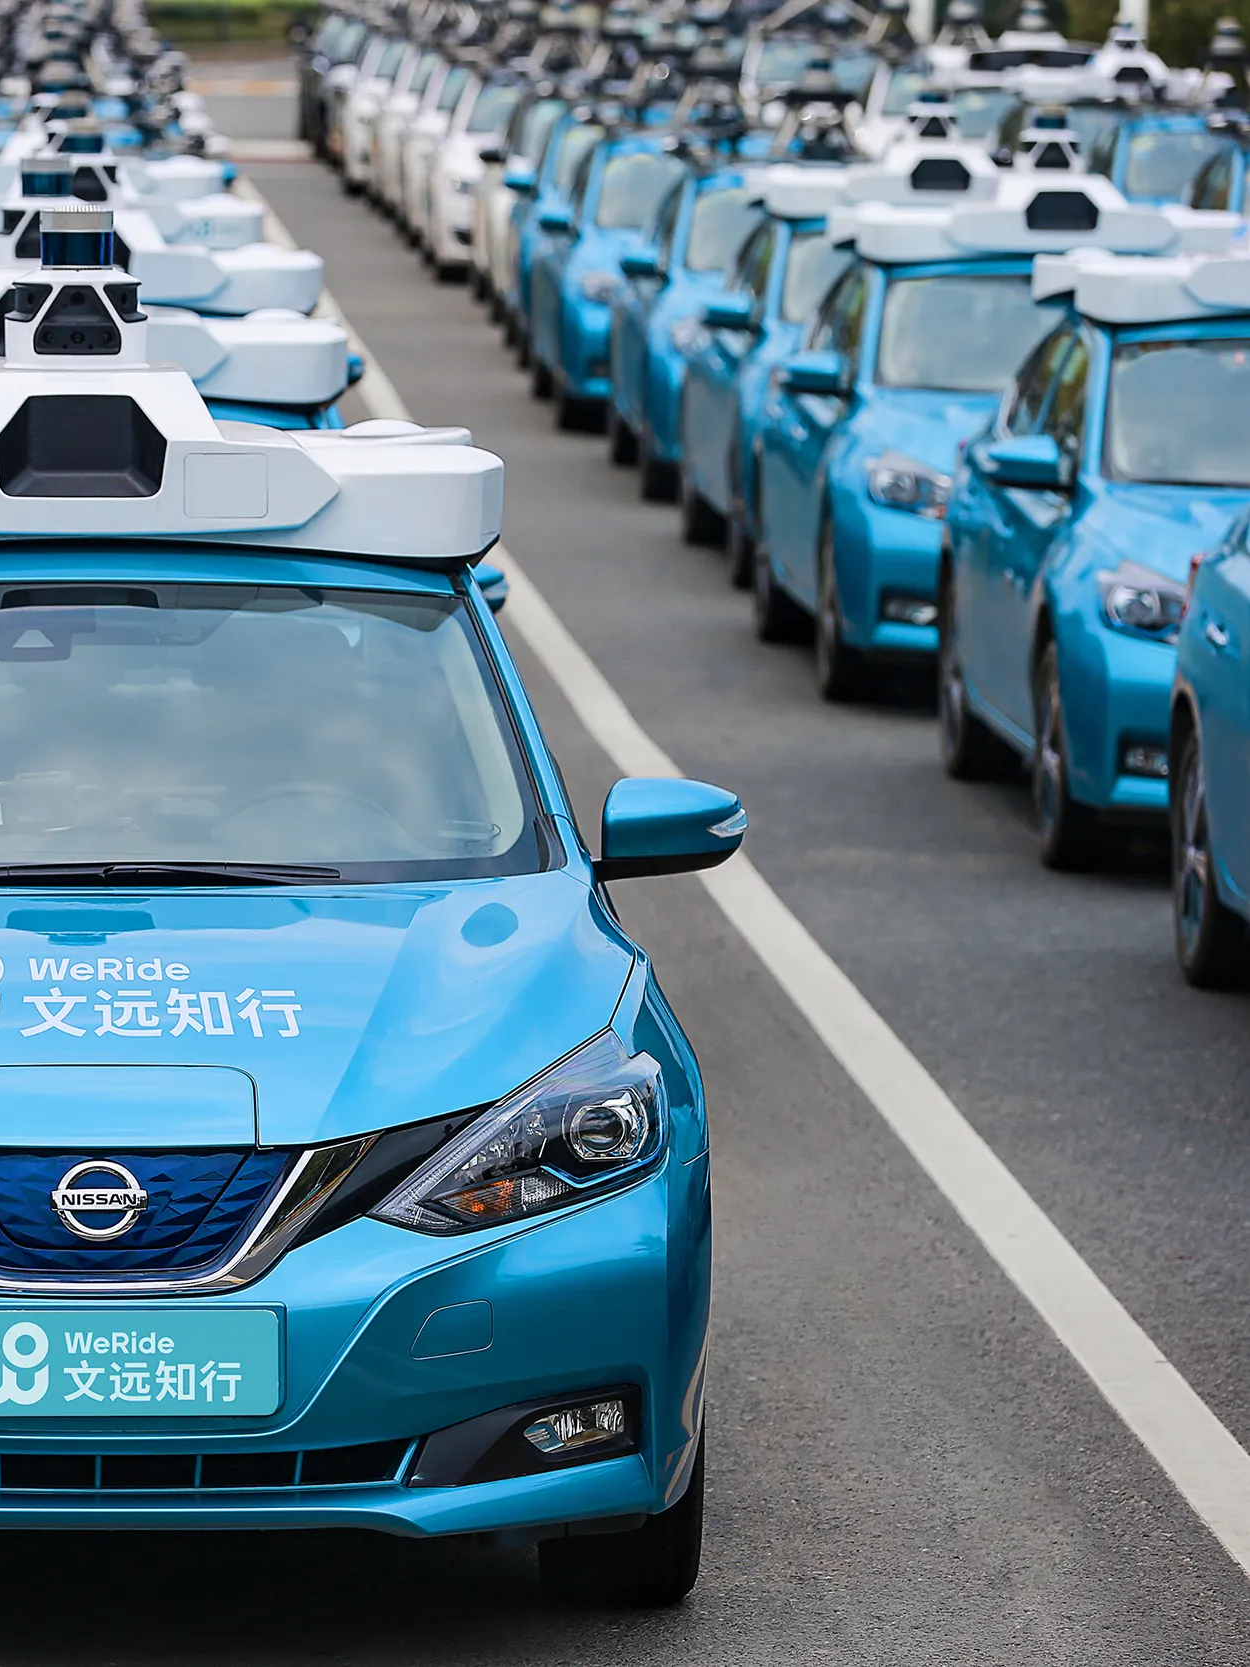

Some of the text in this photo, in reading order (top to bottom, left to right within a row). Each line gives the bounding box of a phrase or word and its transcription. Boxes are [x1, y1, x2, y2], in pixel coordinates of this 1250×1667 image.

[29, 956, 190, 981] WeRide
[20, 987, 302, 1037] 文远知行
[61, 1193, 137, 1206] NISSAN
[64, 1331, 175, 1355] WeRide
[63, 1359, 242, 1402] 文远知行
